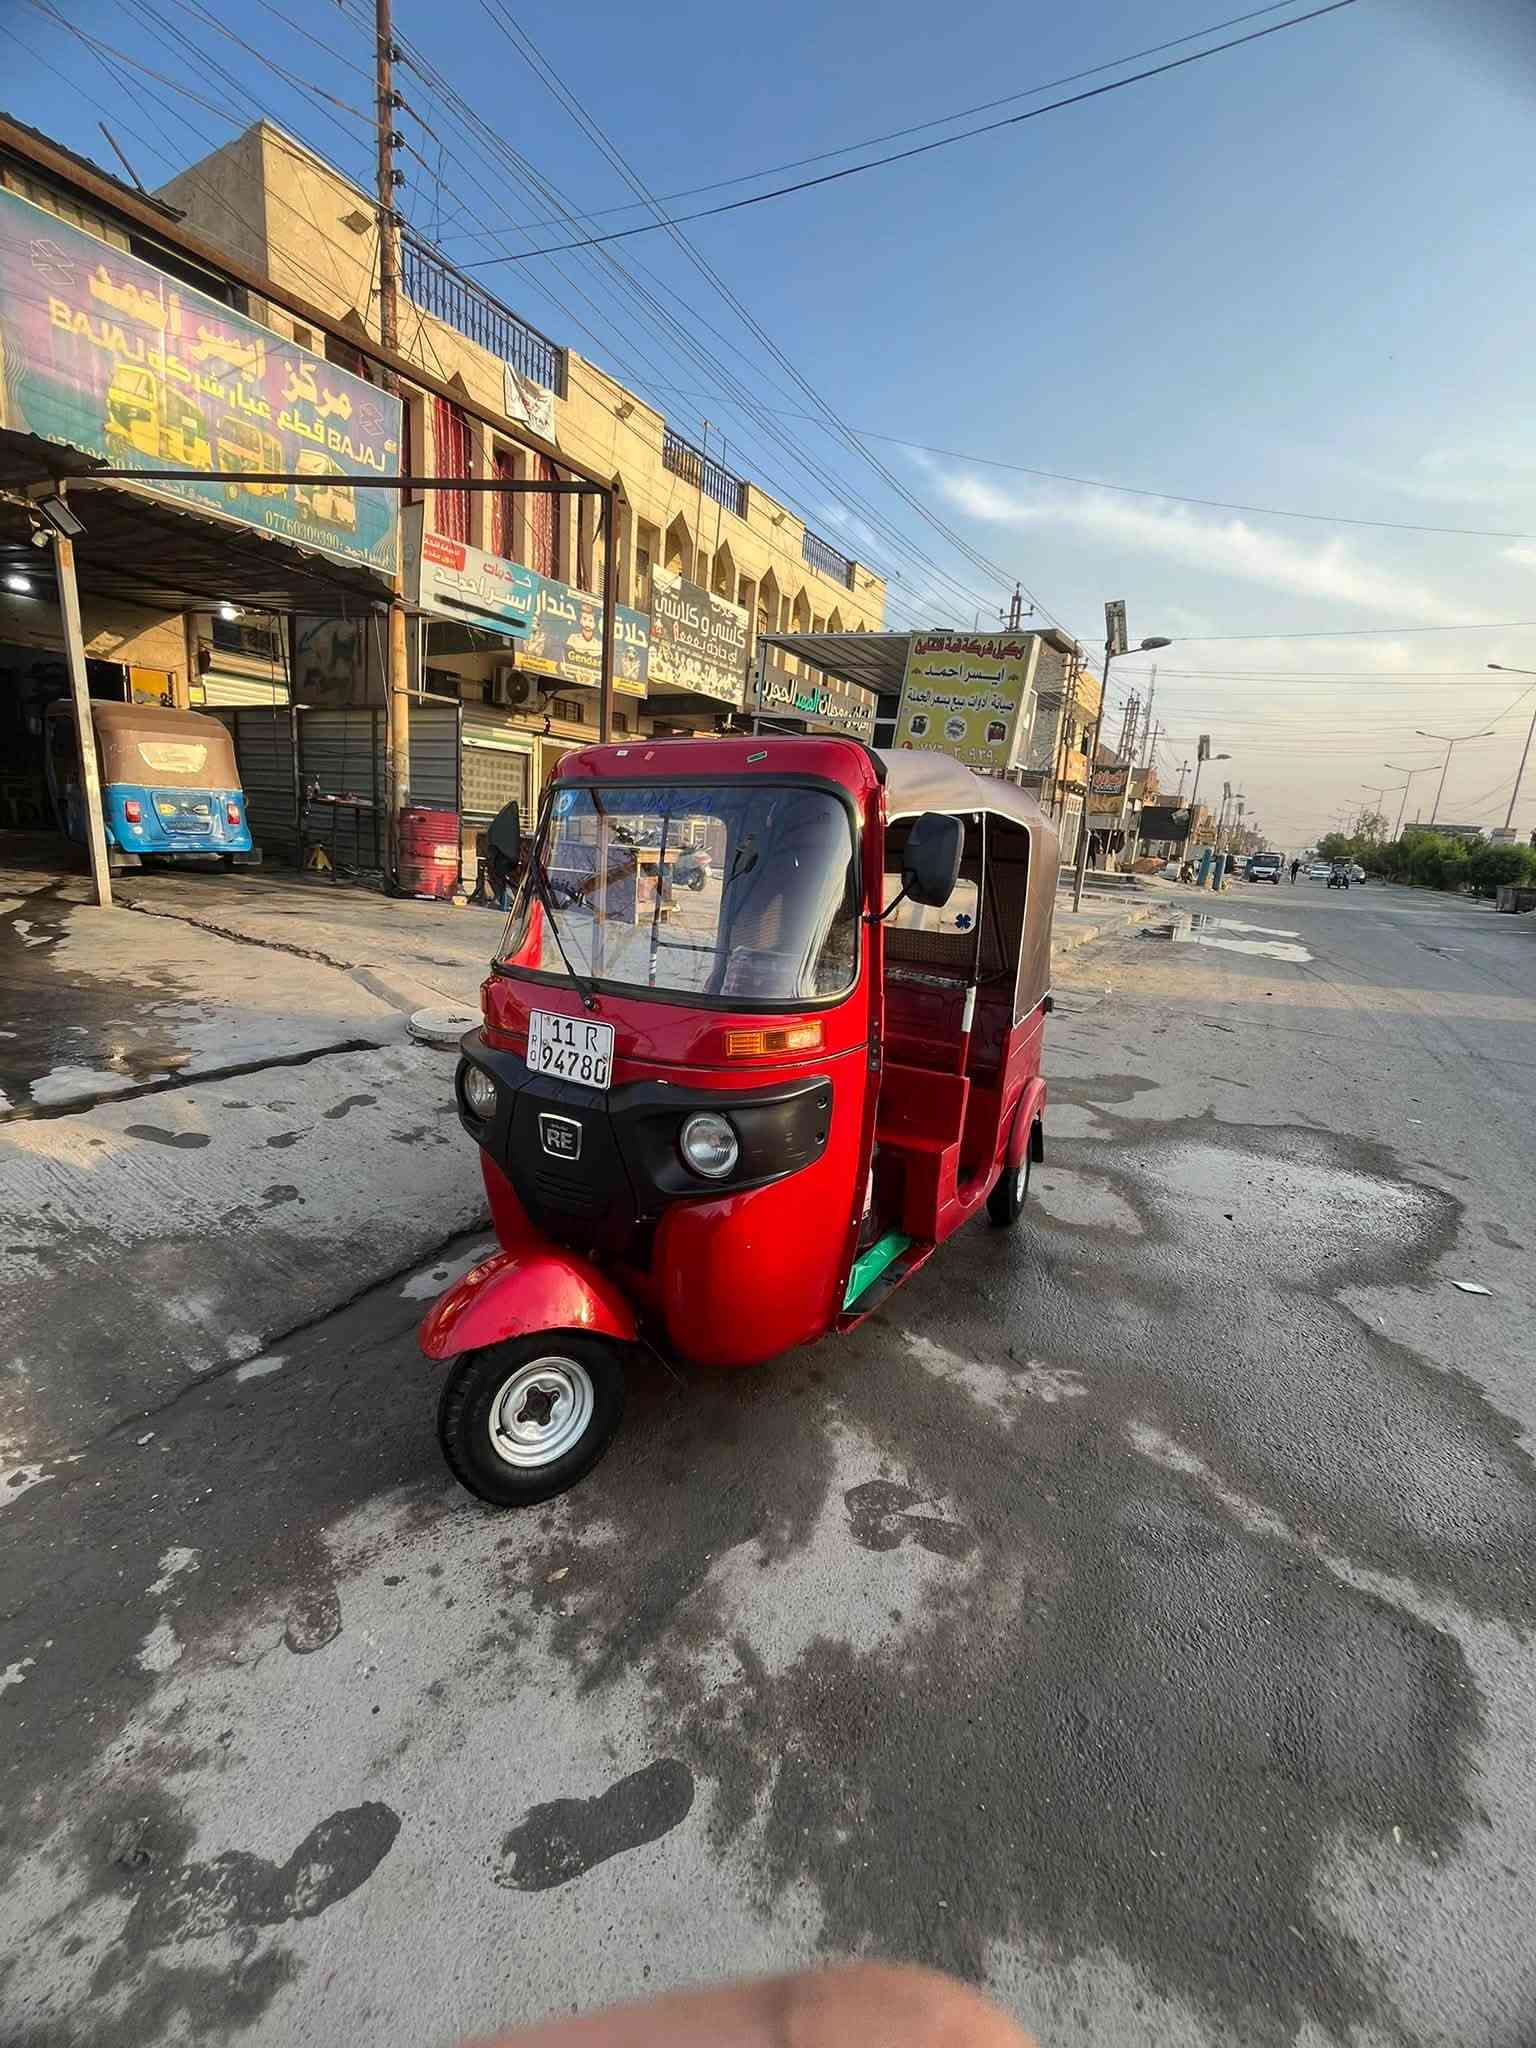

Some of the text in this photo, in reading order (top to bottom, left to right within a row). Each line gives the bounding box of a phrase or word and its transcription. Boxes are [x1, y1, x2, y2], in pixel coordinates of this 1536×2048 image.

[48, 296, 145, 362] BAJAJ
[229, 383, 273, 419] غيار
[280, 360, 352, 420] مركز
[277, 410, 326, 445] قطع
[327, 428, 386, 472] BAJAJ
[535, 590, 577, 625] جندار
[552, 1019, 598, 1052] 11 R
[542, 1046, 607, 1085] 94780
[546, 1127, 574, 1150] RE
